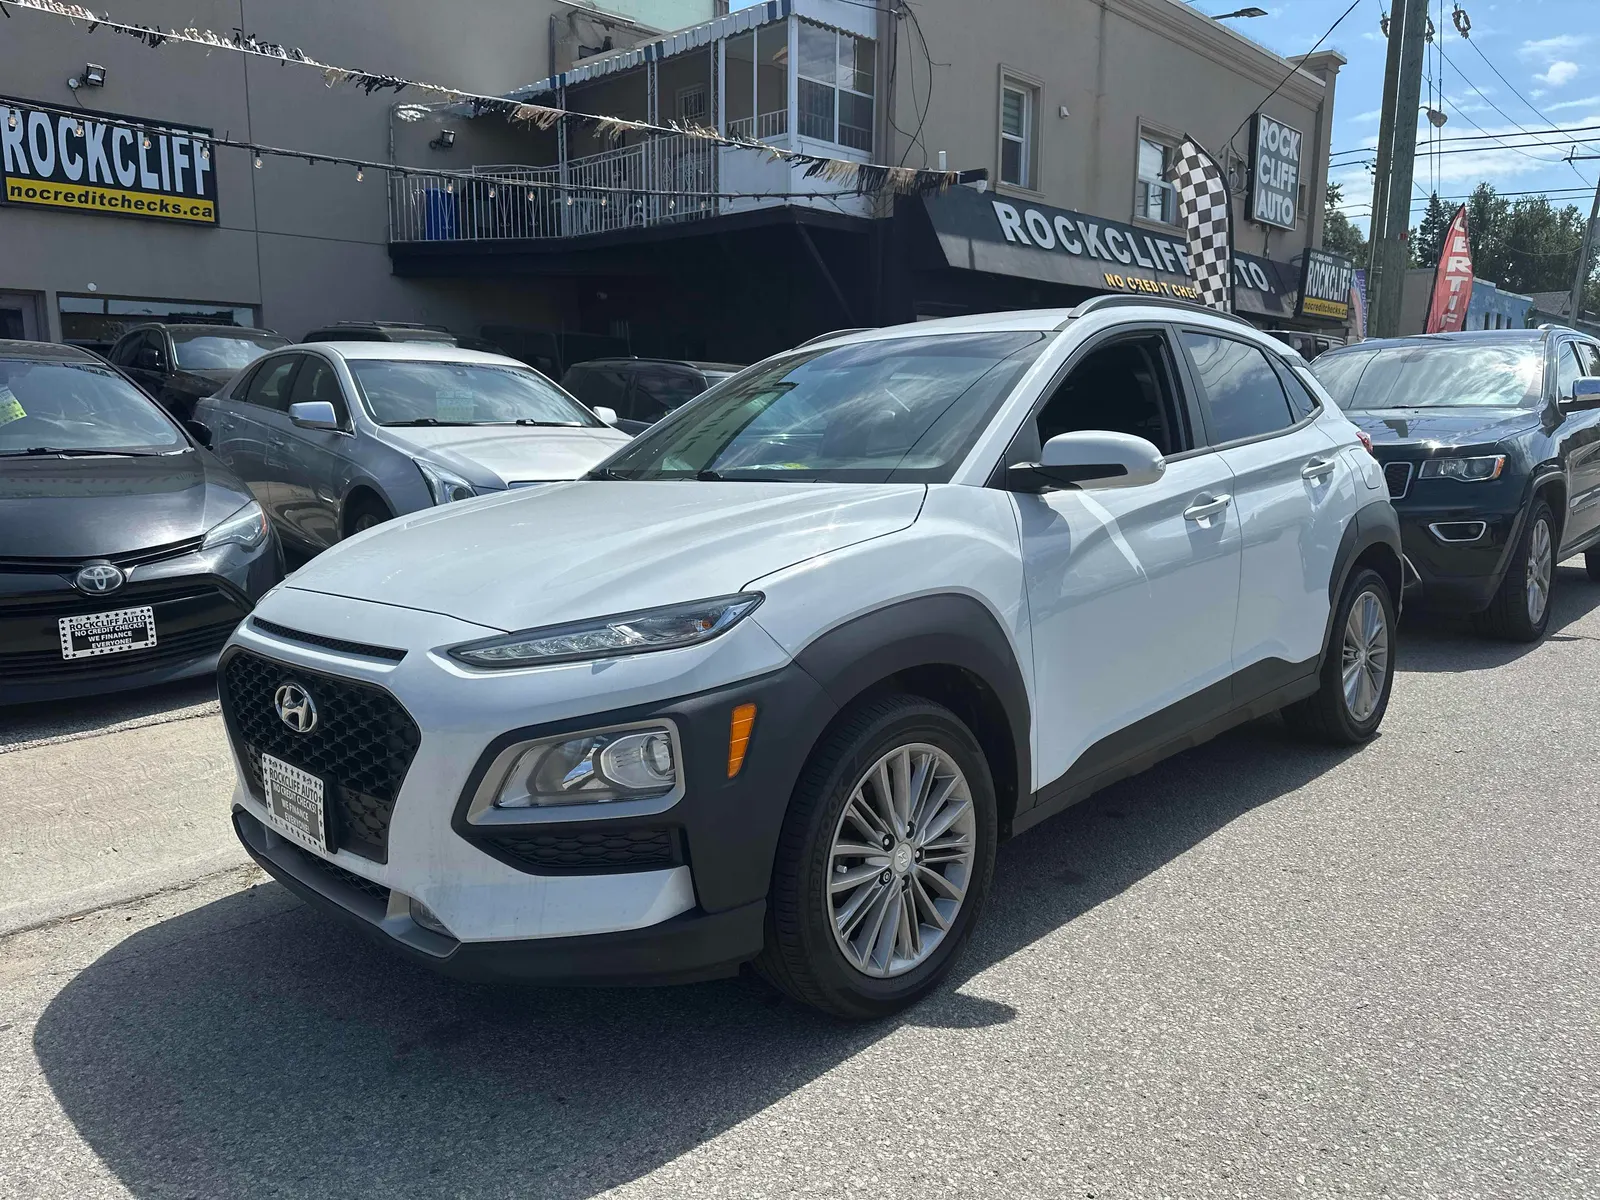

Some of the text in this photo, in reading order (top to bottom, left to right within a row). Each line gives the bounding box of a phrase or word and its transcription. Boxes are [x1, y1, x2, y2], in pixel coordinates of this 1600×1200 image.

[0, 107, 210, 195] ROCKCLIFF
[1260, 117, 1300, 161] ROCK
[1260, 155, 1296, 192] CLIFF
[9, 184, 213, 218] nocreditchecks.ca
[1257, 189, 1294, 225] AUTO
[992, 200, 1276, 294] ROCKCLIFF TO.
[1104, 273, 1125, 290] NO
[1126, 276, 1169, 295] CREDIT
[1305, 260, 1351, 303] ROCKCLIFF
[1440, 216, 1472, 333] CERTIF
[69, 614, 147, 631] ROCKCLIFF AUTO
[88, 626, 114, 635] CREDIT
[101, 631, 132, 640] FINANCE
[92, 638, 132, 649] EVERYONE!
[269, 768, 319, 803] ROCKCLIFF AUTO
